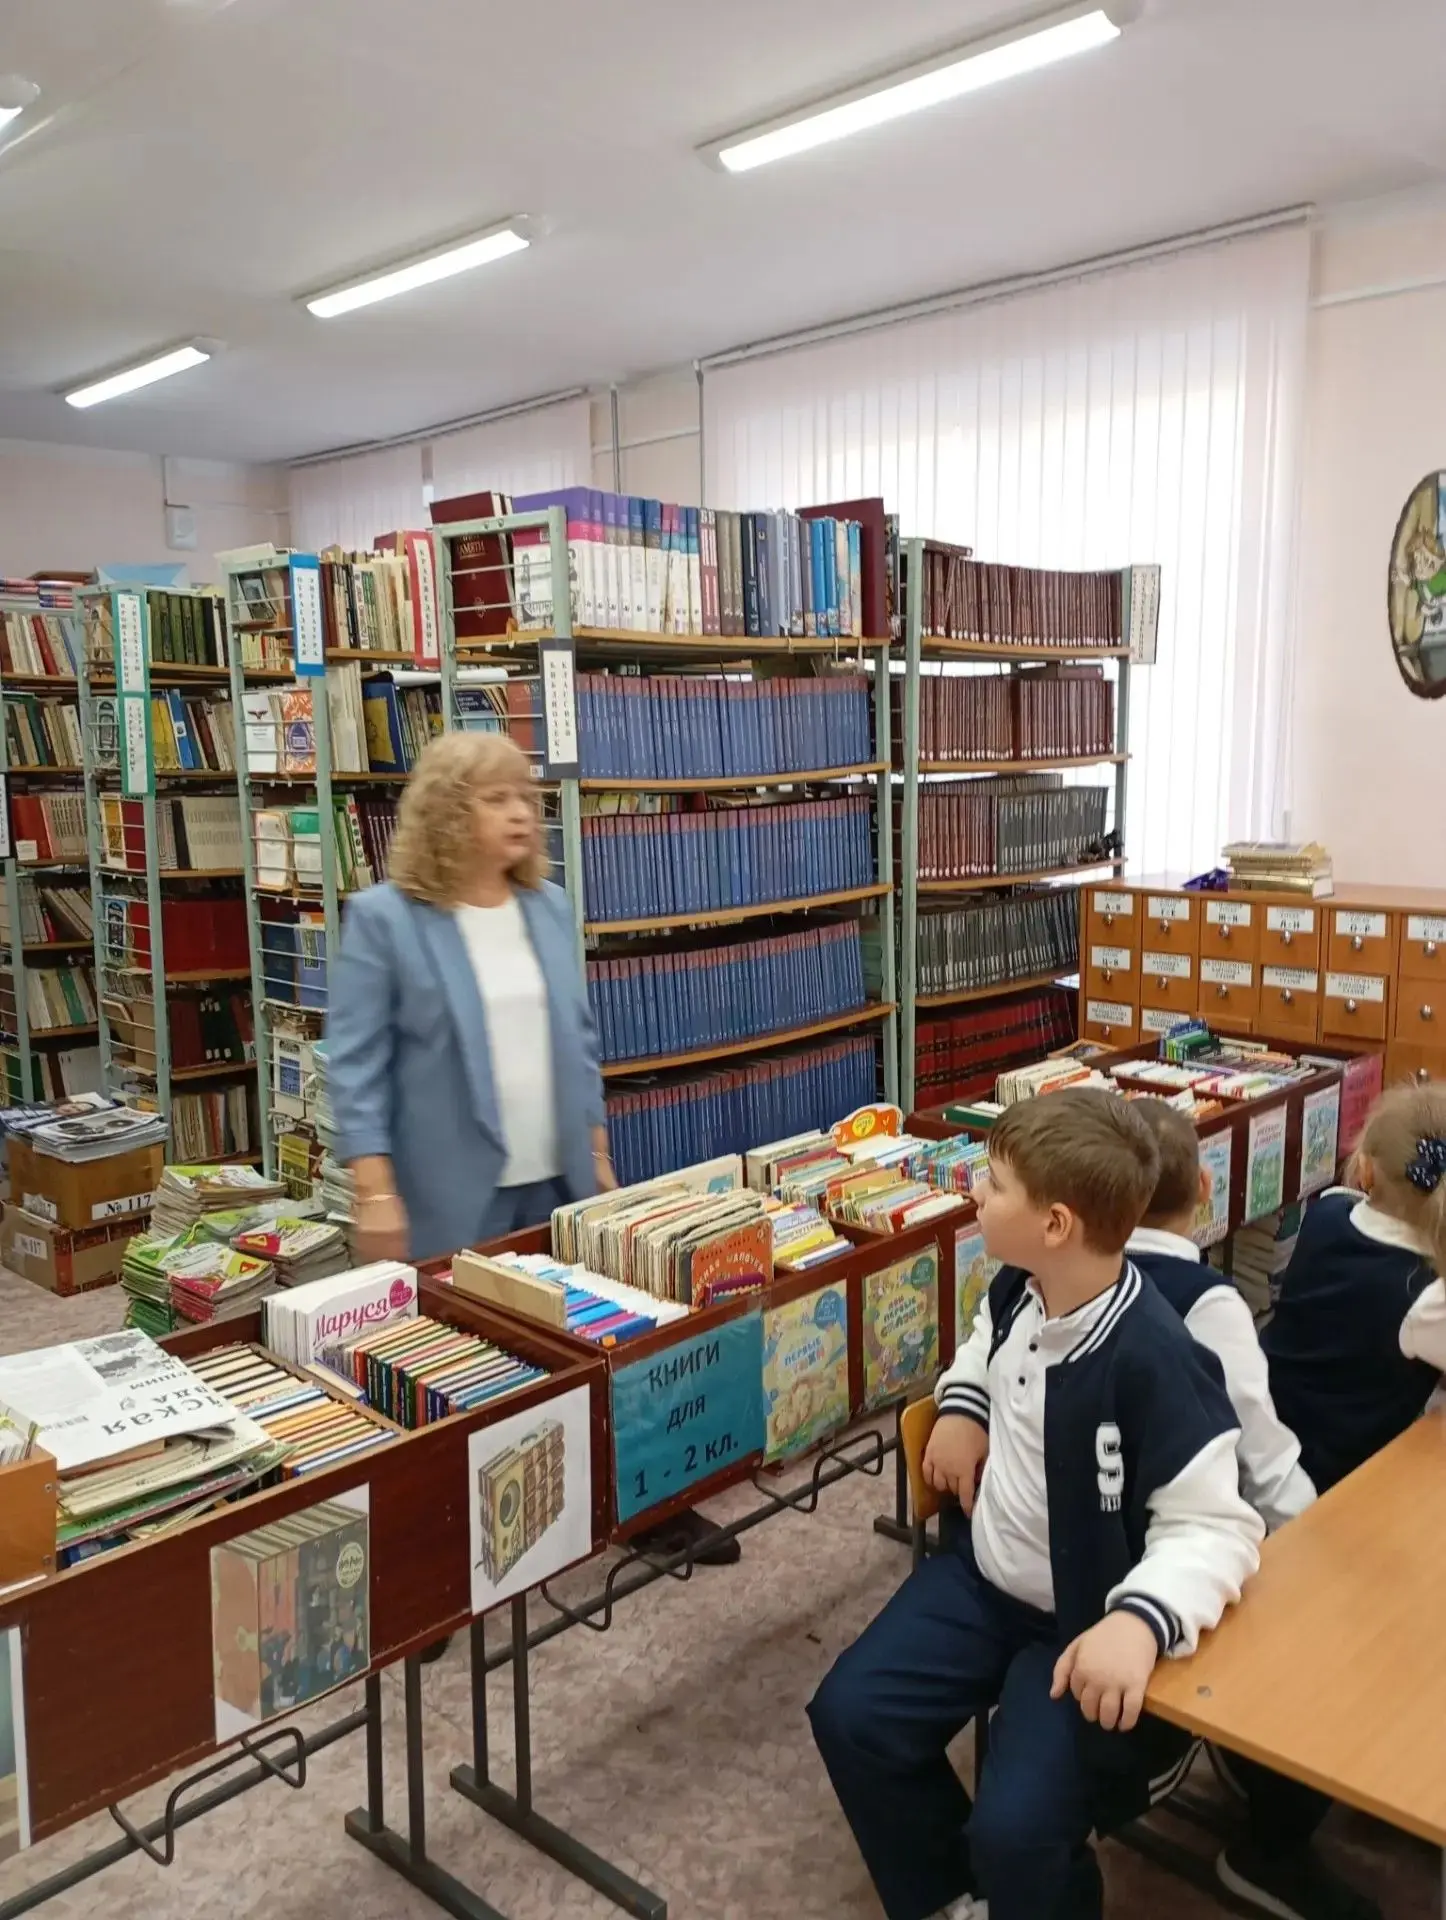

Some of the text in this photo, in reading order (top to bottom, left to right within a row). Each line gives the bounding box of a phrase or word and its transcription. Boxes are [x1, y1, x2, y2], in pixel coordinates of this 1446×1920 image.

[128, 1195, 151, 1210] 117
[313, 1298, 389, 1346] Маруся
[649, 1340, 720, 1392] КНИГИ
[634, 1469, 648, 1498] 1
[684, 1444, 698, 1473] 2
[1095, 1421, 1125, 1496] S
